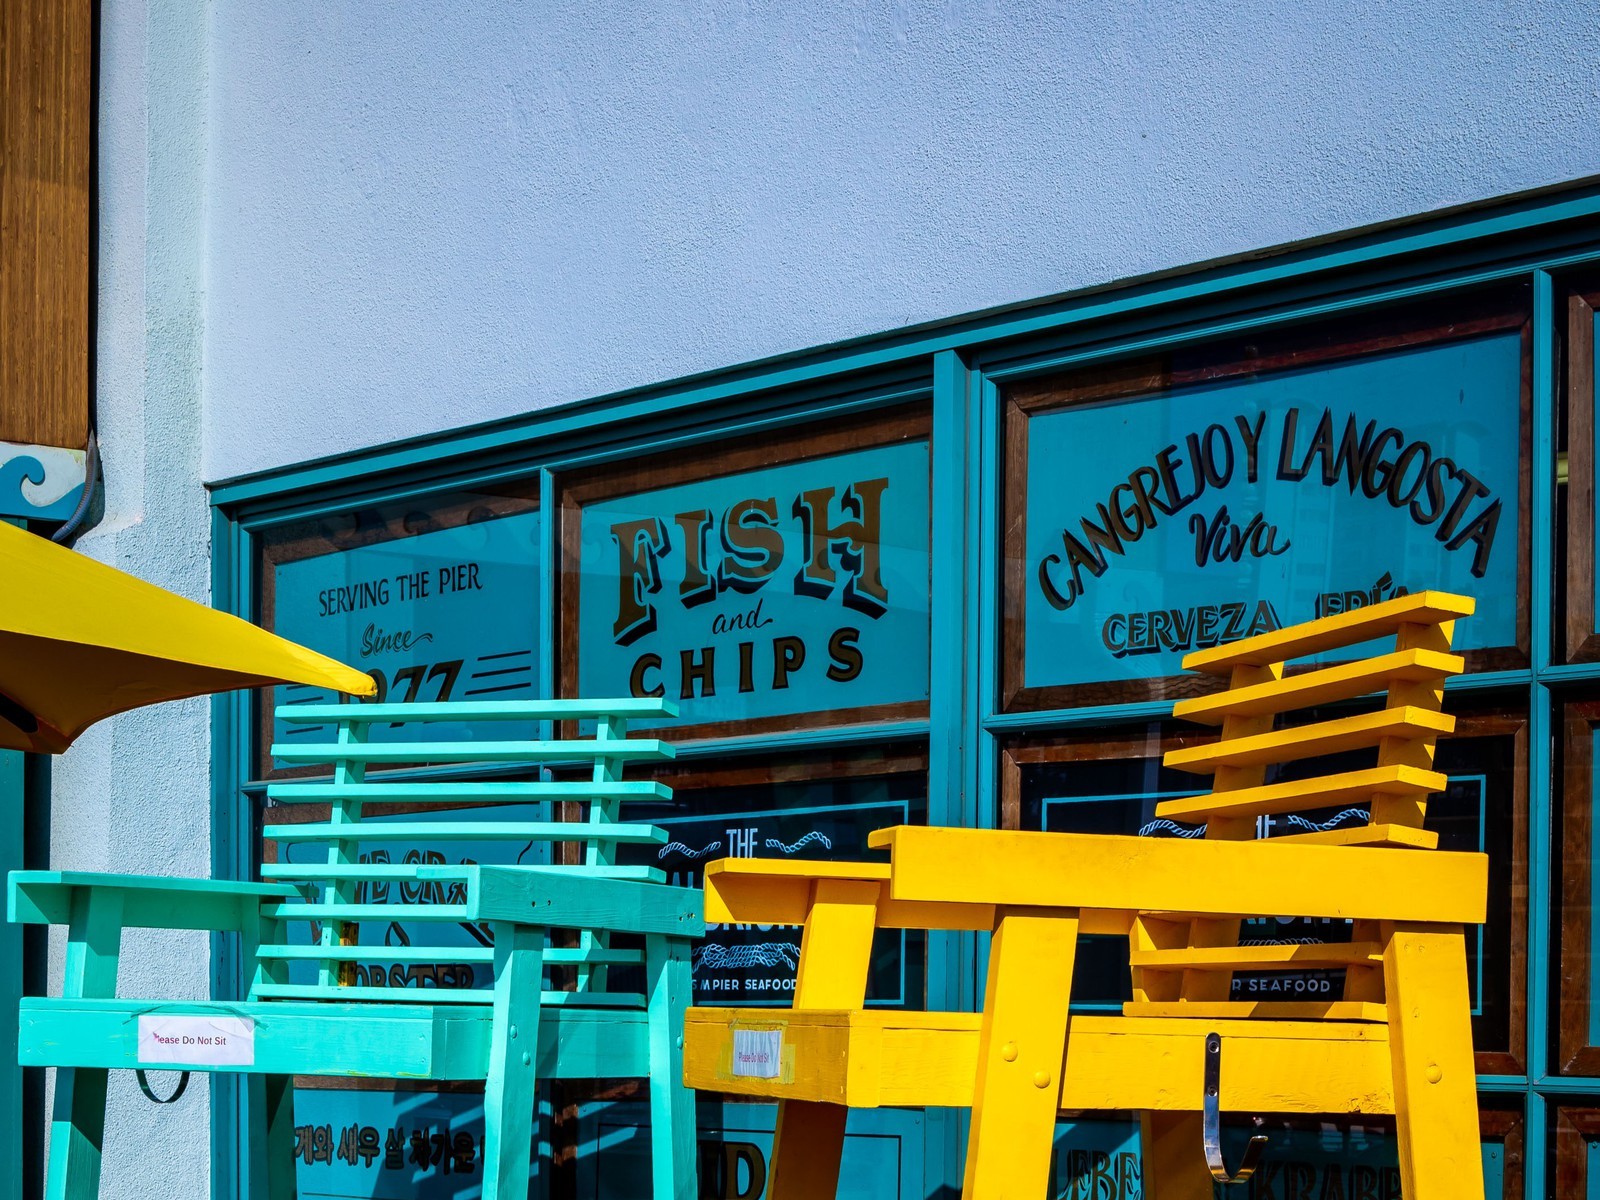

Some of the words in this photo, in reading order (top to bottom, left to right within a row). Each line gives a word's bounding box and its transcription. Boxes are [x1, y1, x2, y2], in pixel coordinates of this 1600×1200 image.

[1038, 423, 1235, 611] CANGREJO
[1235, 410, 1266, 483] Y
[1276, 406, 1503, 579] LANGOSTA
[1189, 505, 1290, 568] Viva
[611, 477, 889, 647] FISH
[319, 579, 390, 617] SERVING
[396, 571, 430, 601] THE
[439, 563, 483, 595] PIER
[360, 622, 433, 658] Since
[712, 598, 774, 635] and
[1102, 599, 1284, 659] CERVEZA
[629, 626, 864, 700] CHIPS
[726, 828, 758, 858] THE
[713, 979, 740, 991] PIER
[744, 979, 796, 991] SEAFOOD
[1249, 978, 1331, 993] SEAFOOD
[153, 1032, 180, 1045] lease
[182, 1036, 195, 1045] Do
[197, 1036, 213, 1046] Not
[214, 1036, 226, 1046] Sit
[295, 1124, 334, 1166] 게와
[337, 1122, 380, 1169] 새우
